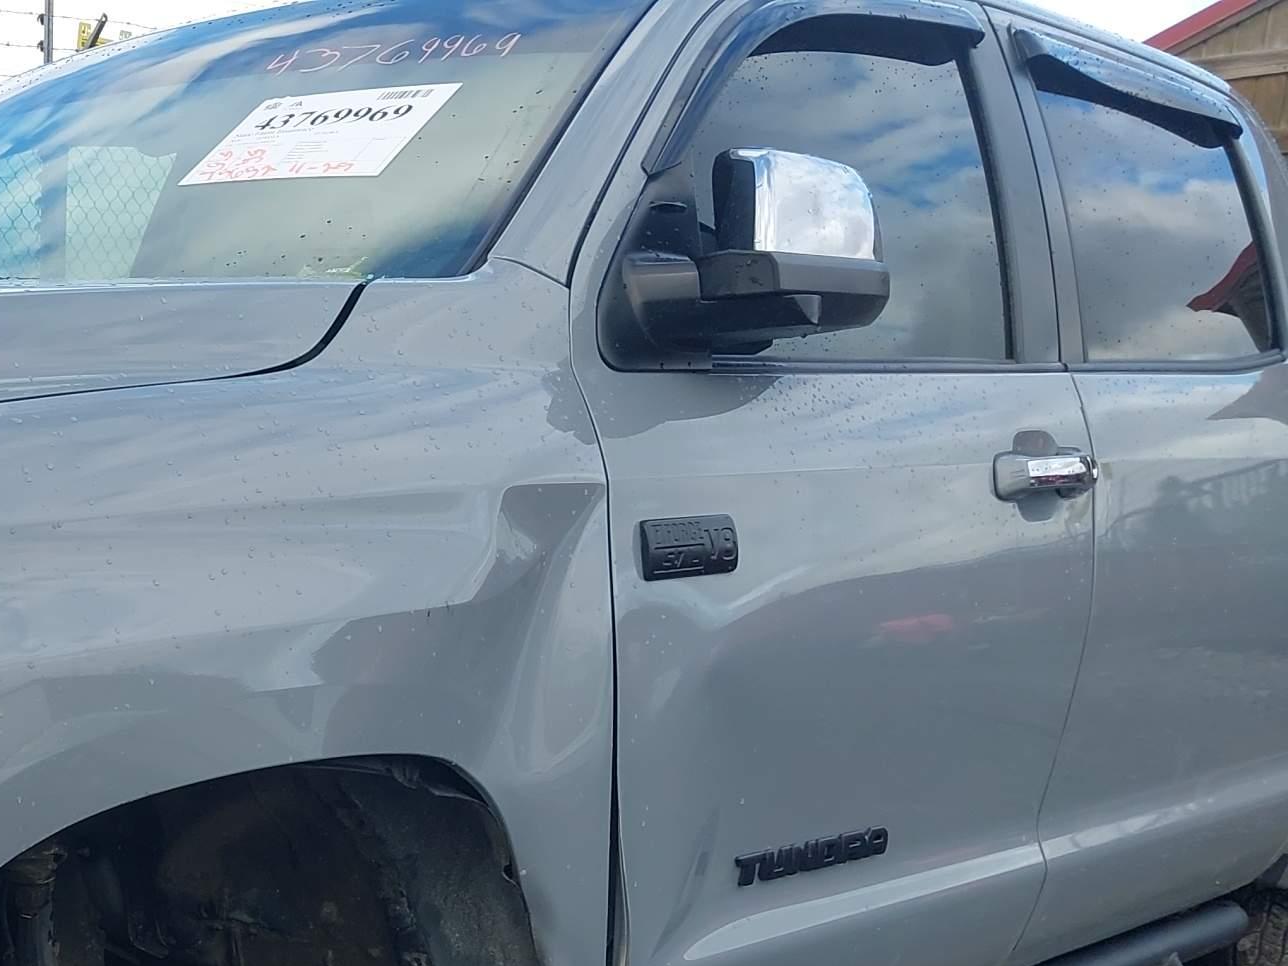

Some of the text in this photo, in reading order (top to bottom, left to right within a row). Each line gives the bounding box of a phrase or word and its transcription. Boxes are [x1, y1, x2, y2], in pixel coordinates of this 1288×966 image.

[265, 32, 522, 76] 43769969
[254, 103, 414, 131] 43769969
[734, 825, 889, 887] TUNDRA
